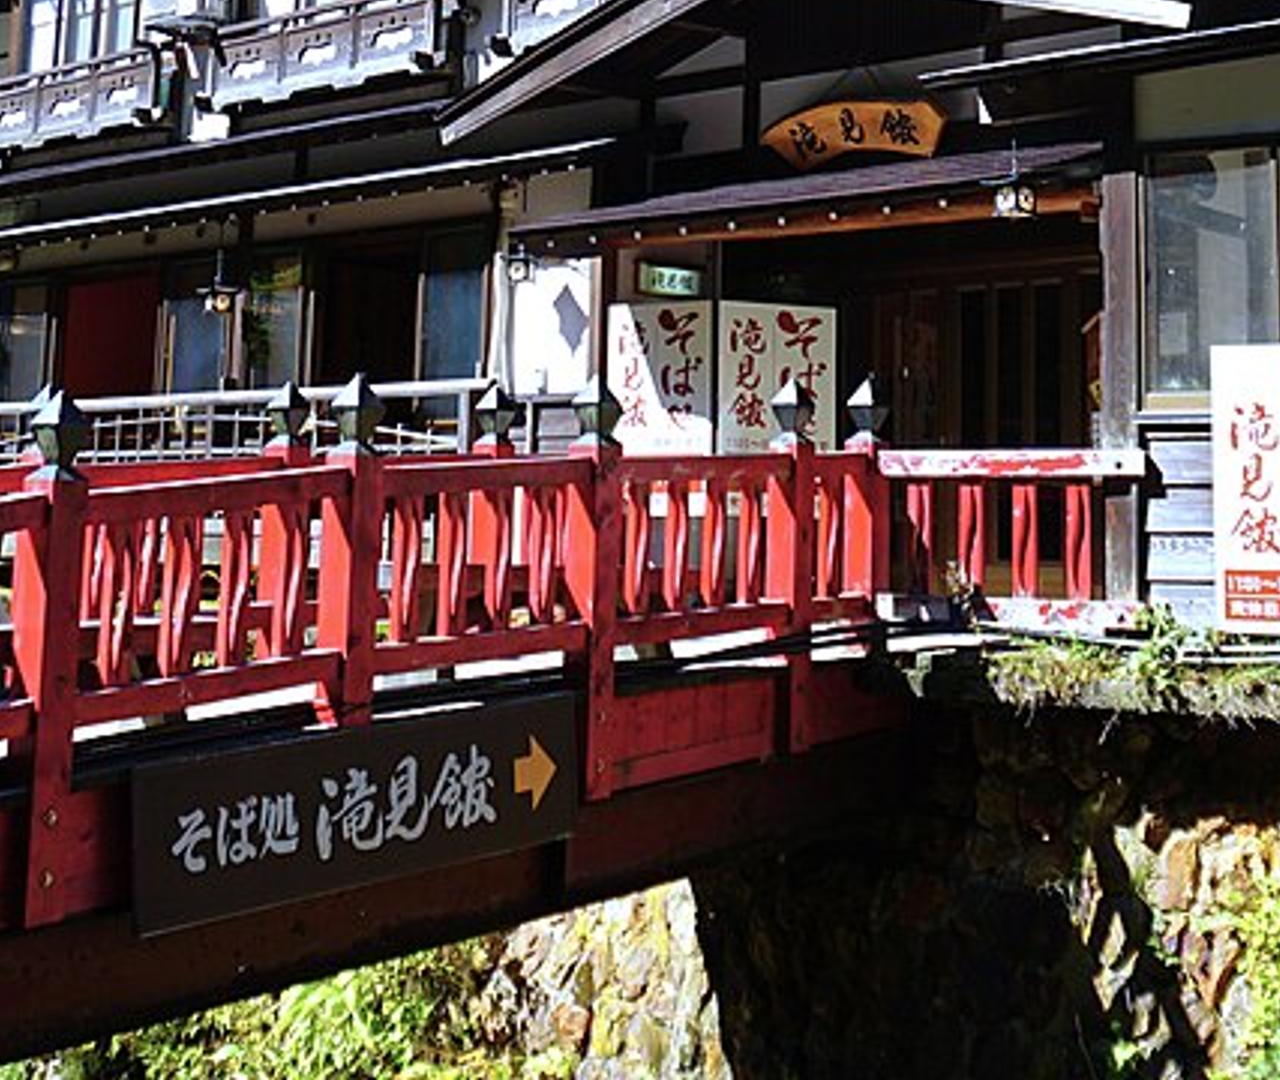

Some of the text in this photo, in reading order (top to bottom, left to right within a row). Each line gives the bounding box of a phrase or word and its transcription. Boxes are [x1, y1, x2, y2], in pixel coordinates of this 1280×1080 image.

[788, 107, 920, 157] 滝見館
[727, 317, 769, 430] 滝見館
[776, 309, 829, 436] そば
[171, 743, 498, 874] そば処 滝見館
